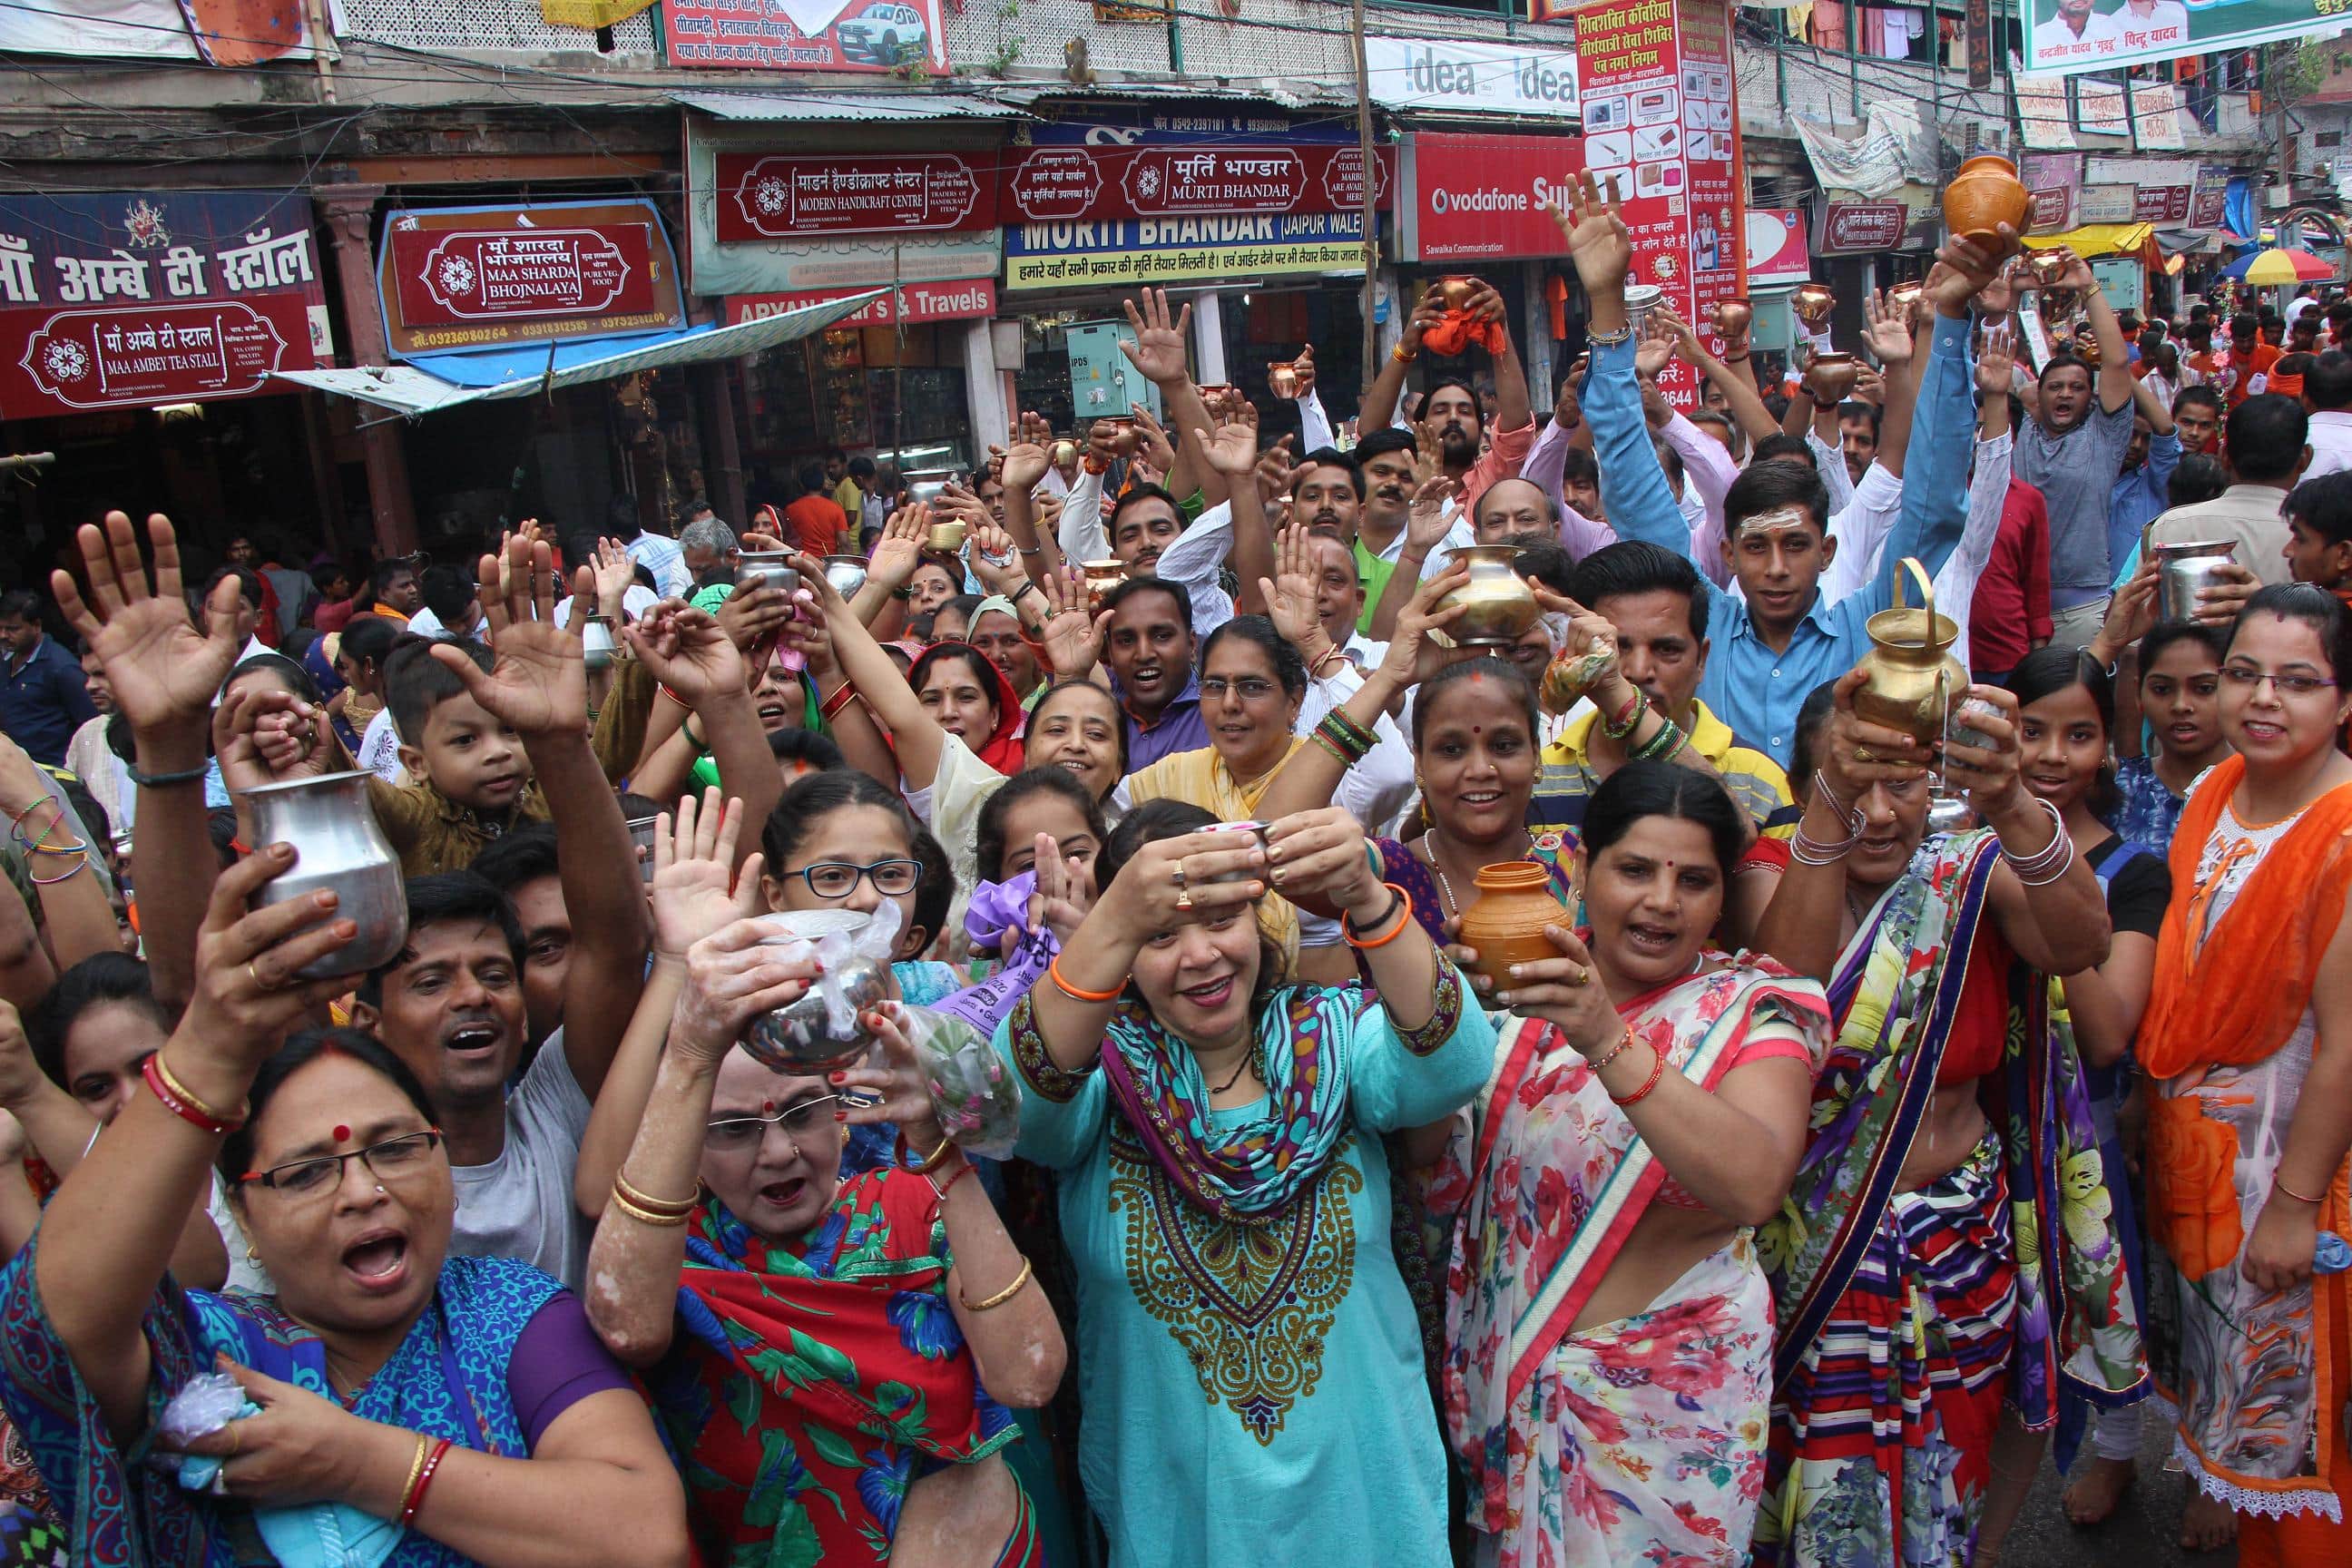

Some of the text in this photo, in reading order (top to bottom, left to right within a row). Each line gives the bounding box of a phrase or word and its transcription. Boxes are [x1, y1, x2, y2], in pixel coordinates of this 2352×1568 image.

[2072, 42, 2092, 54] यादव
[2151, 26, 2179, 42] यादव
[1172, 116, 1225, 132] 0542-2397181
[1174, 153, 1292, 184] मूर्ति भण्डार
[798, 169, 829, 191] माडर्न
[893, 167, 922, 189] सेन्टर
[1331, 183, 1345, 191] ARE
[1171, 183, 1290, 201] MURTI BHANDAR
[1450, 187, 1527, 211] vodafone
[799, 193, 922, 212] MODERN HANDICRAFT CENTRE
[930, 198, 967, 206] HANDICRAFT
[1139, 214, 1273, 246] BHANDAR
[1280, 213, 1325, 240] (JAIPUR
[1330, 212, 1364, 240] WALE)
[1638, 225, 1650, 235] का
[1652, 219, 1675, 233] सबसे
[486, 237, 564, 254] माँ शारदा
[1454, 242, 1504, 254] Communication
[55, 227, 314, 302] अम्बे टी स्टॉल
[485, 250, 573, 267] भोजनालय
[1019, 260, 1044, 281] हमारे
[1047, 259, 1066, 279] यहाँ
[1068, 258, 1088, 277] सभी
[1091, 260, 1116, 278] प्रकार
[1119, 255, 1131, 273] की
[1133, 254, 1152, 279] मूर्ति
[1154, 253, 1177, 271] तैयार
[1179, 252, 1206, 270] मिलती
[1223, 250, 1237, 269] एवं
[1275, 251, 1287, 264] पर
[1298, 247, 1318, 263] तैयार
[1319, 246, 1338, 262] किया
[1340, 248, 1359, 261] जाता
[487, 266, 577, 282] MAA SHARDA
[583, 270, 603, 279] PURE
[592, 278, 612, 286] FOOD
[489, 283, 579, 299] BHOJNALAYA
[916, 288, 988, 314] Travels
[103, 322, 214, 353] माँ अम्बे टी स्टाल
[106, 352, 220, 376] MAA AMBEY TEA STALL
